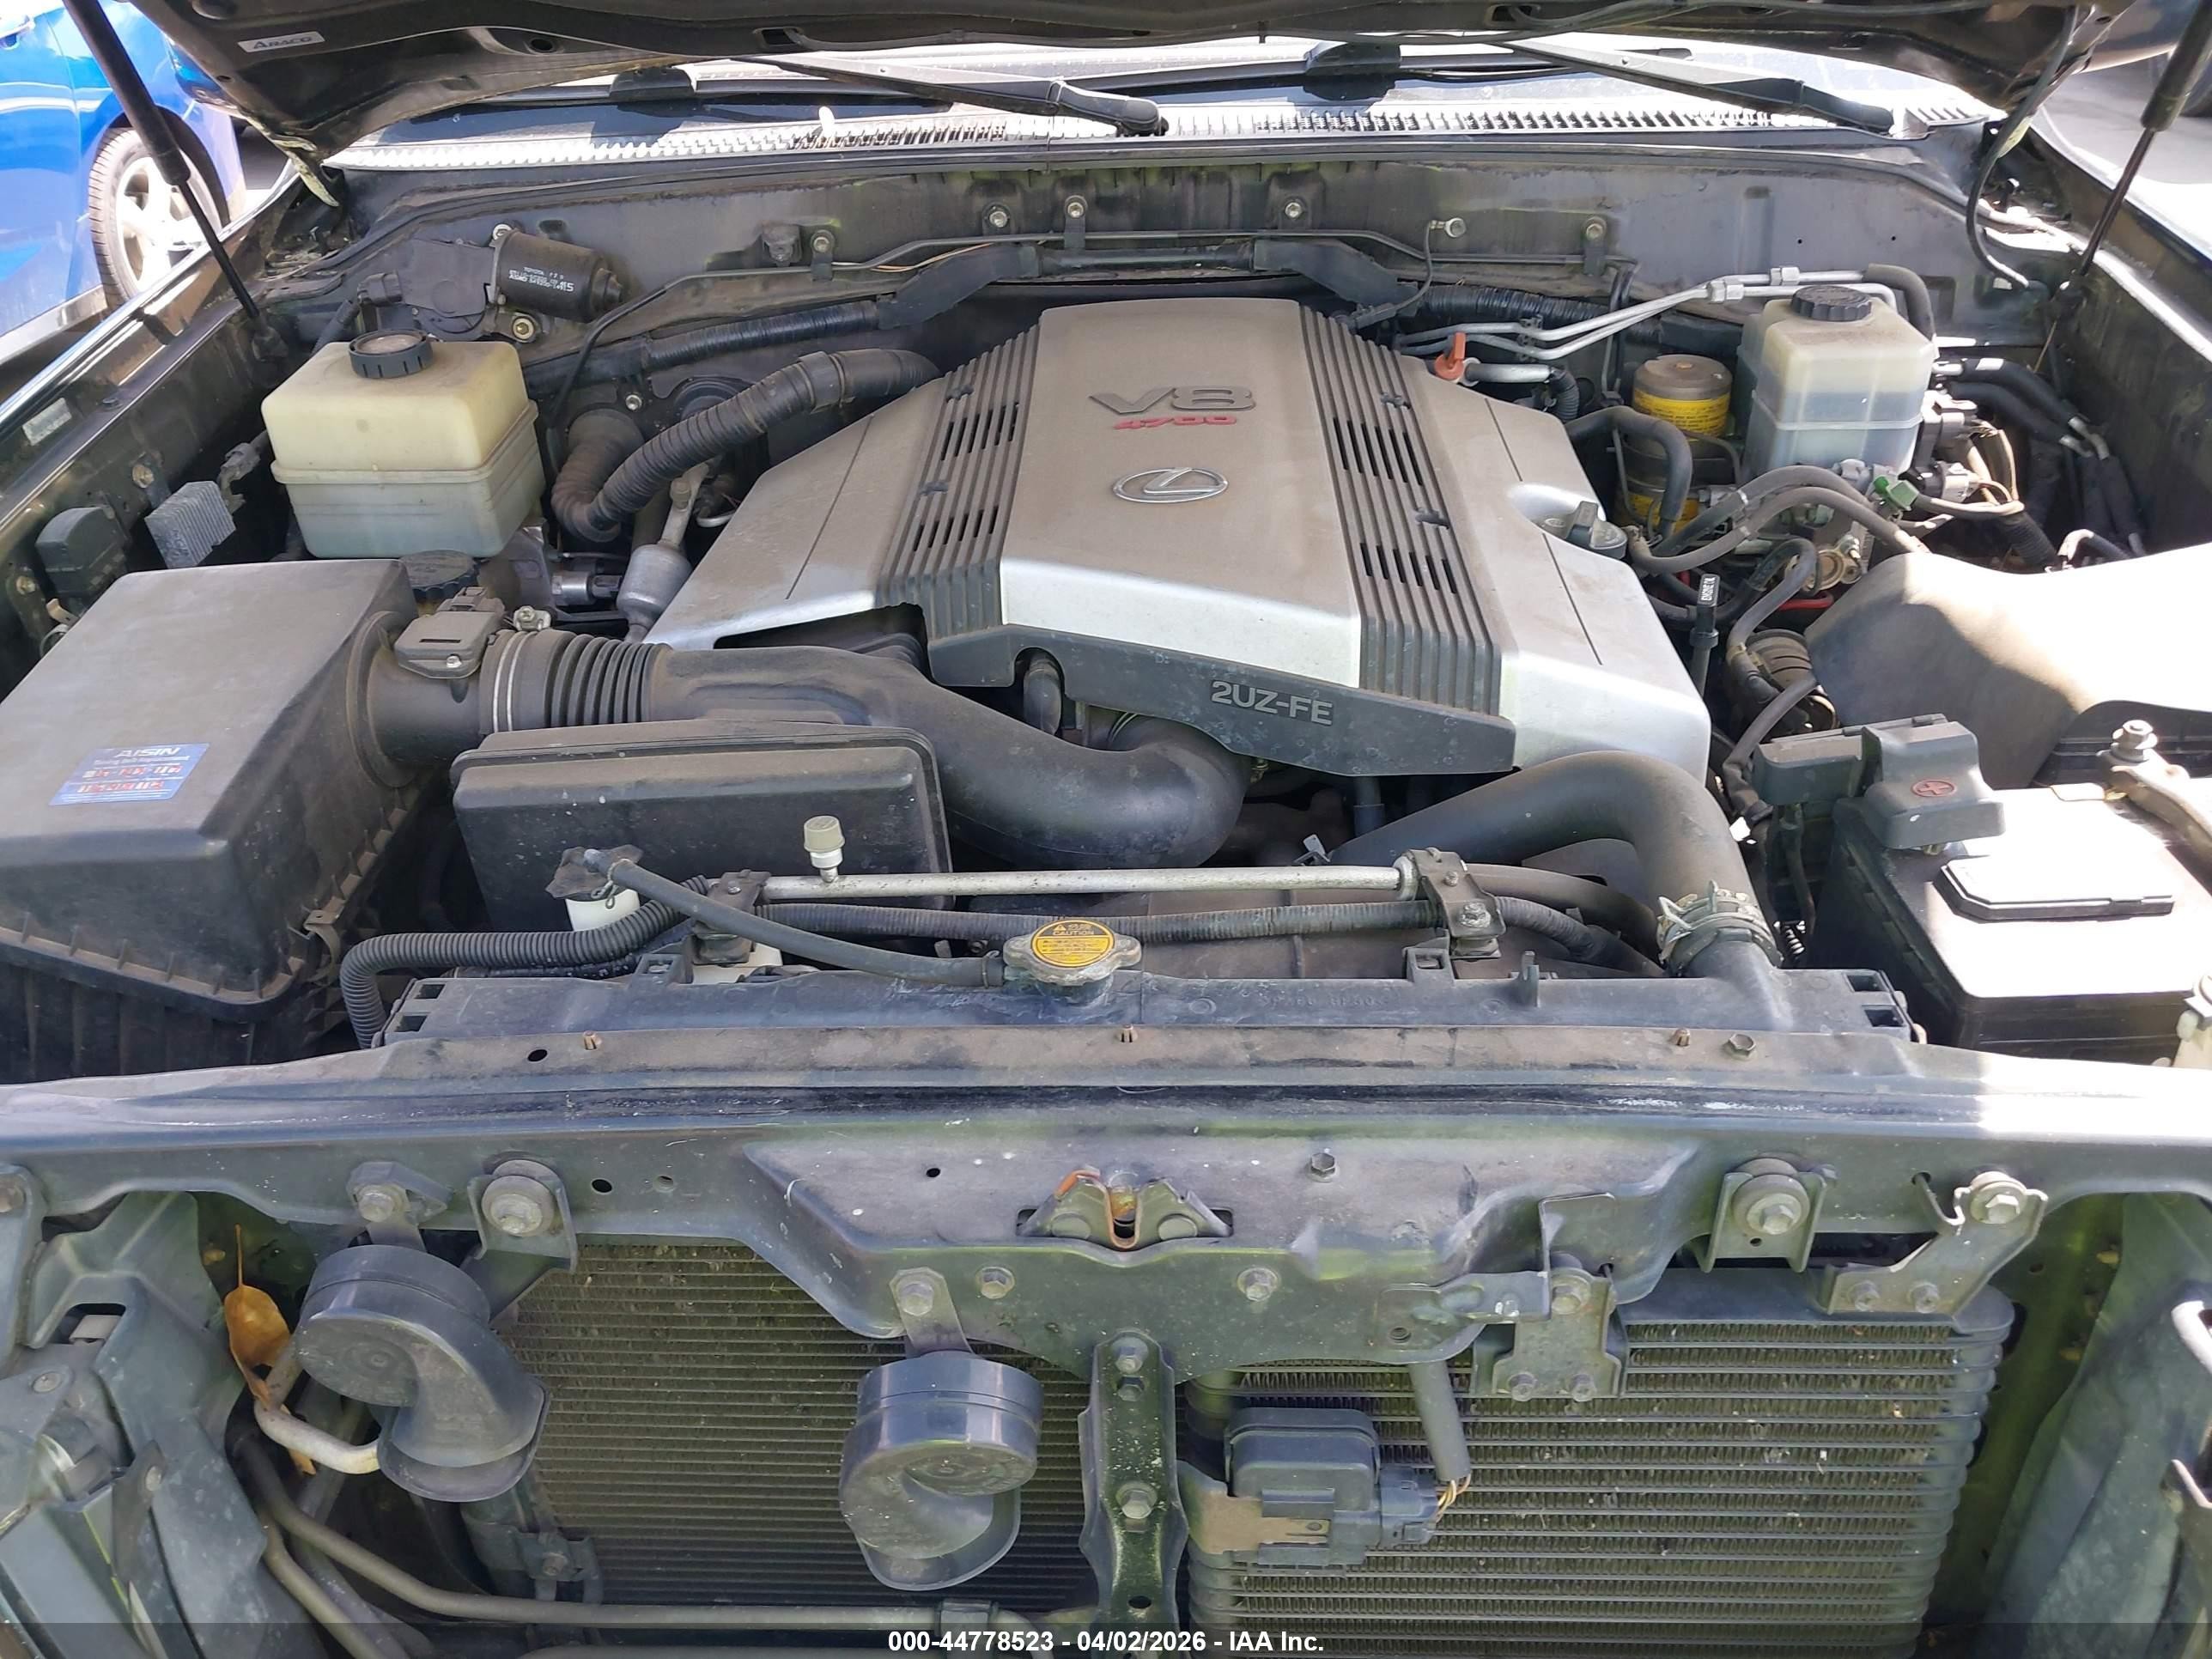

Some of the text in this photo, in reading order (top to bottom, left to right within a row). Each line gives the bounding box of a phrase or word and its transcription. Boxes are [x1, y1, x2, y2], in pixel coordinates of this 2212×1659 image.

[1088, 387, 1257, 416] V8
[1113, 416, 1237, 430] 4700
[1211, 680, 1334, 726] 2UZ-FE
[114, 747, 181, 758] AISIN
